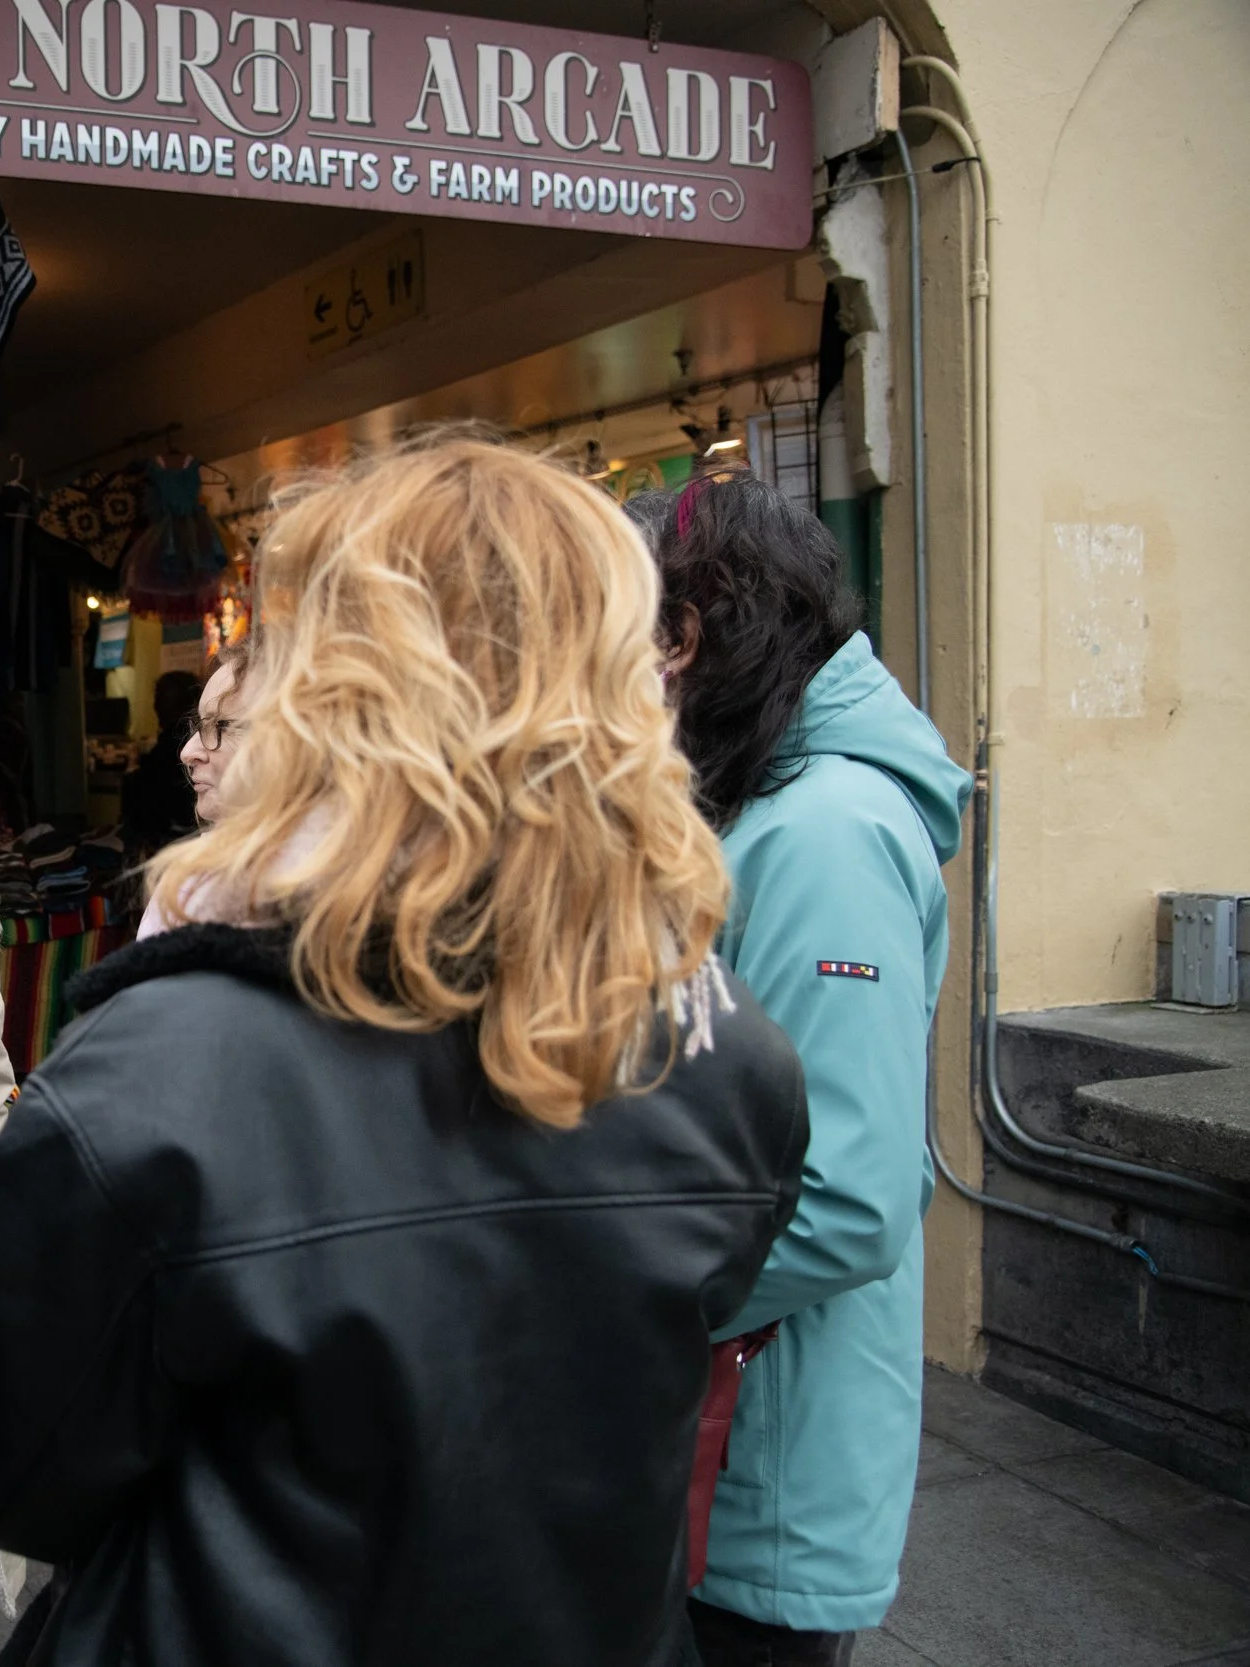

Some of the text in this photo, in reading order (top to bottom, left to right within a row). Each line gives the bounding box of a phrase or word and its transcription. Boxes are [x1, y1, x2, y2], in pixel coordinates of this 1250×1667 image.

[8, 0, 373, 136] NORTH
[405, 36, 776, 170] ARCADE
[21, 118, 235, 176] HANDMADE
[247, 142, 379, 190] CRAFTS
[392, 156, 418, 192] &
[430, 161, 519, 205] FARM
[531, 170, 697, 222] PRODUCTS
